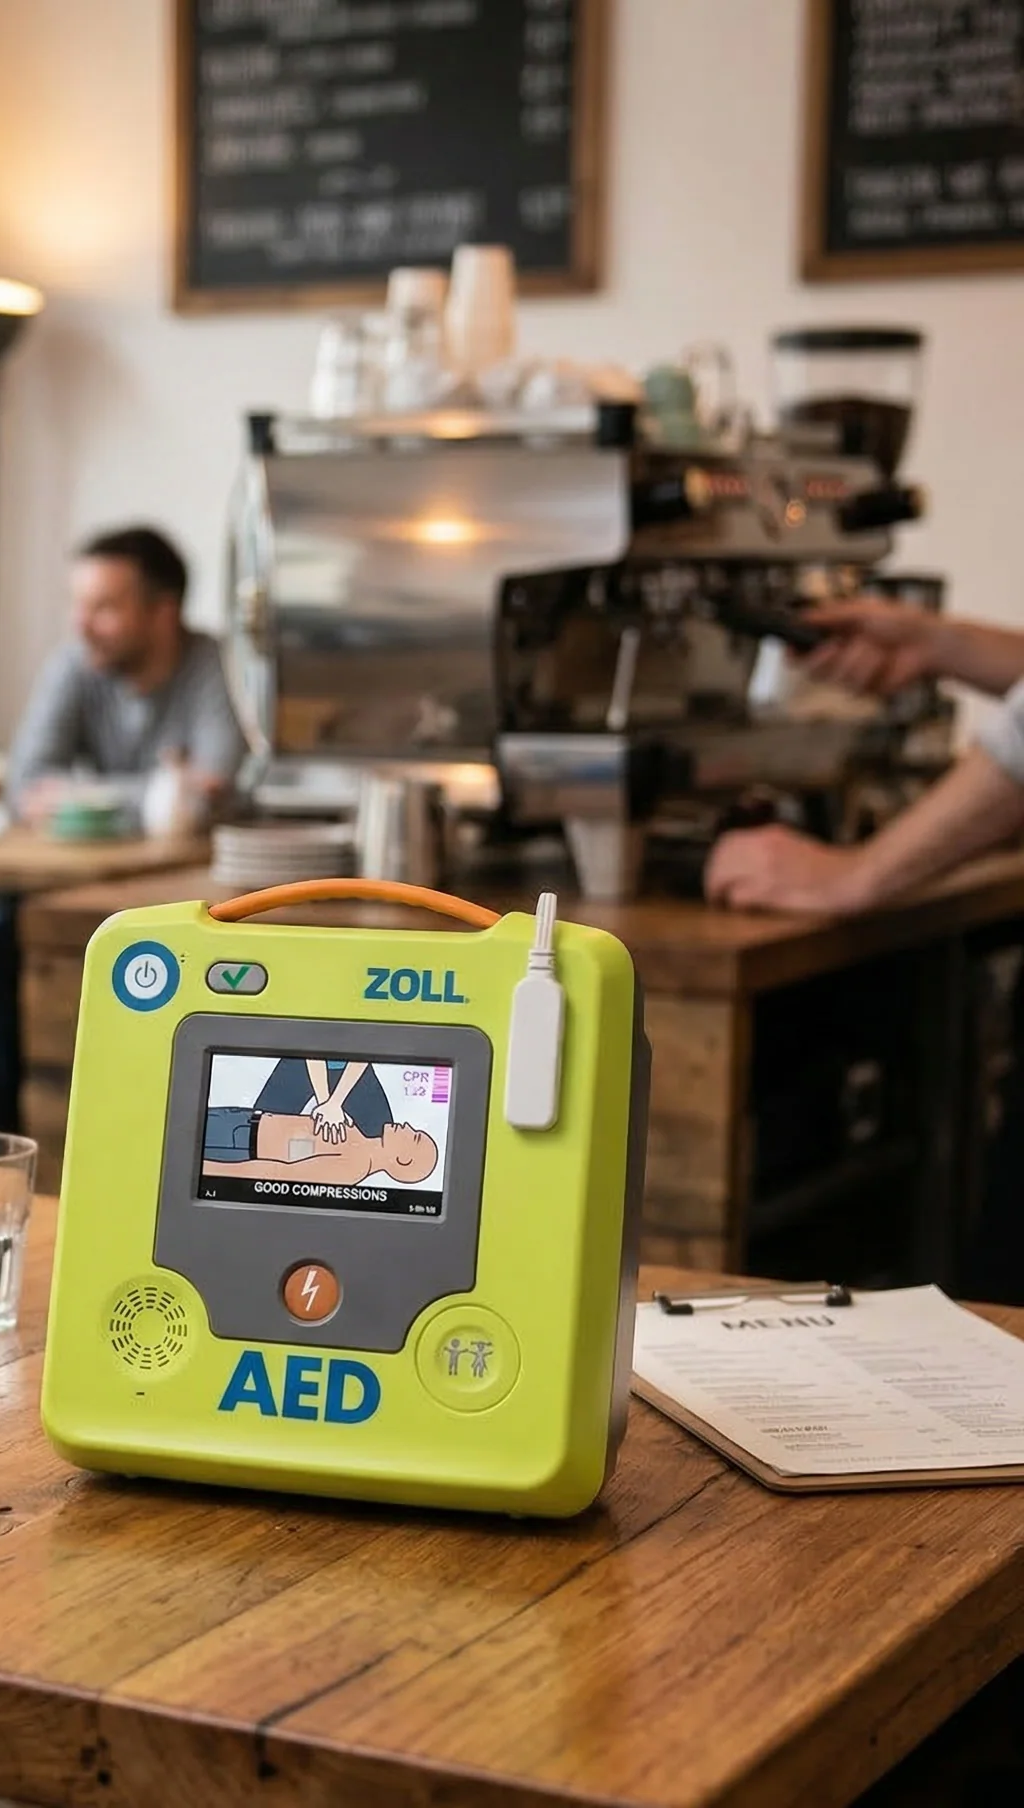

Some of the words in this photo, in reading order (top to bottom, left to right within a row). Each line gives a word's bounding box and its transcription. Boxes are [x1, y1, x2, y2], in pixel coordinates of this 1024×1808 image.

[364, 967, 465, 1003] ZOLL
[403, 1071, 429, 1083] CPR
[254, 1181, 290, 1195] GOOD
[292, 1184, 388, 1202] COMPRESSIONS
[720, 1314, 835, 1331] MENU
[217, 1350, 381, 1424] AED
